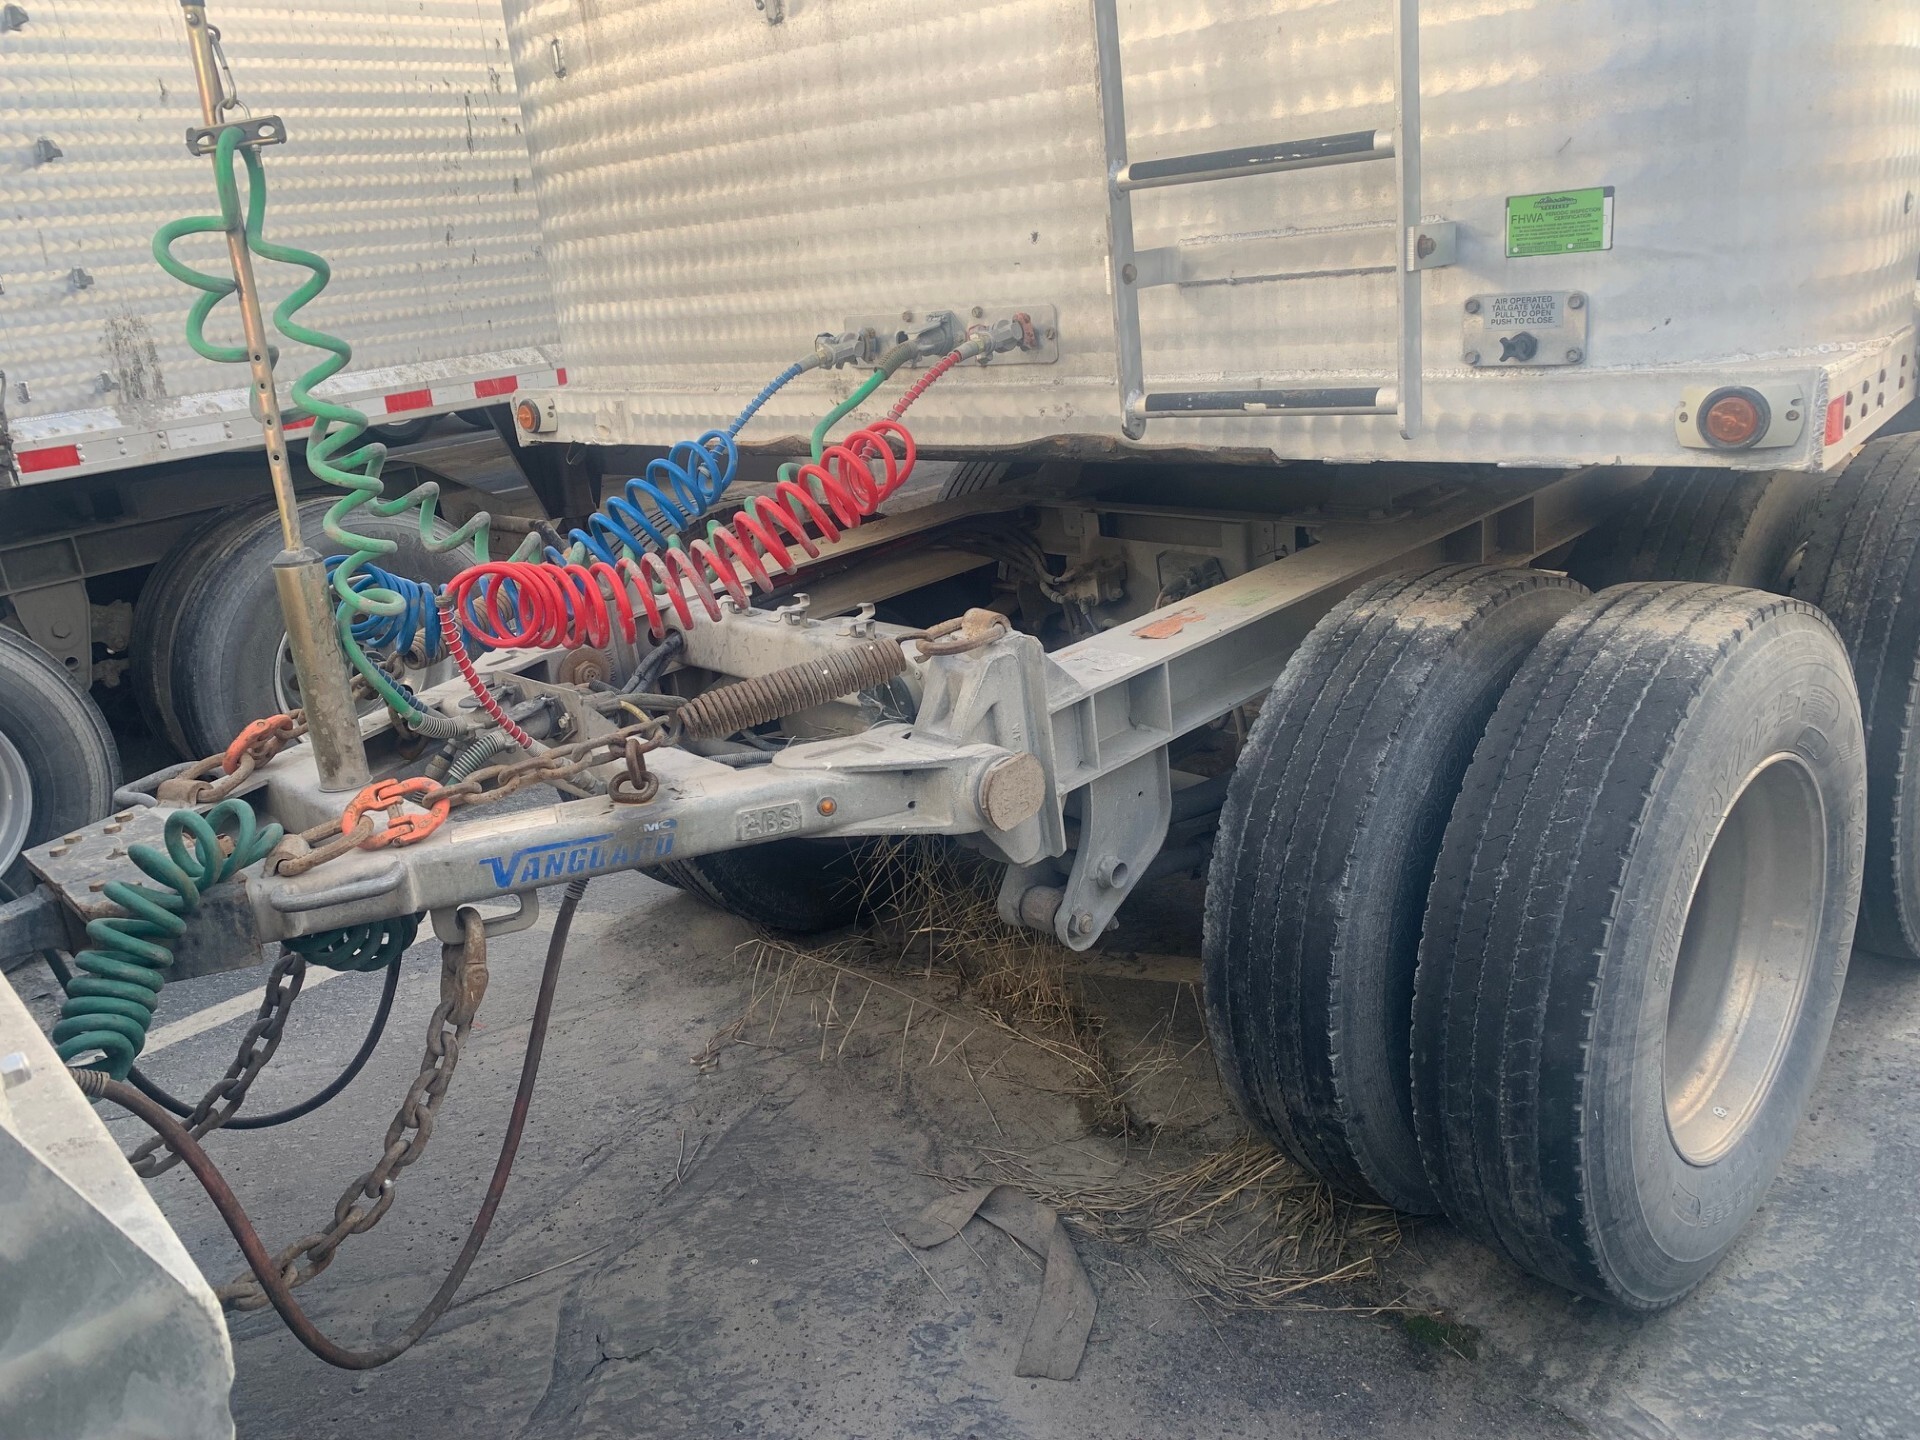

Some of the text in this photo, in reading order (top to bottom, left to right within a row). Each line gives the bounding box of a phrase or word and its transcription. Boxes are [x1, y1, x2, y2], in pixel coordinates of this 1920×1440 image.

[1545, 209, 1569, 217] PERIODIC
[1554, 213, 1592, 221] CERTIFICATION
[1511, 213, 1544, 224] FHWA
[1510, 296, 1553, 304] OPERATED
[1492, 302, 1555, 312] TAILGATE VALVE
[1517, 310, 1528, 318] TO
[1529, 309, 1552, 317] OPEN
[1514, 317, 1525, 325] TO
[742, 807, 793, 838] ABS
